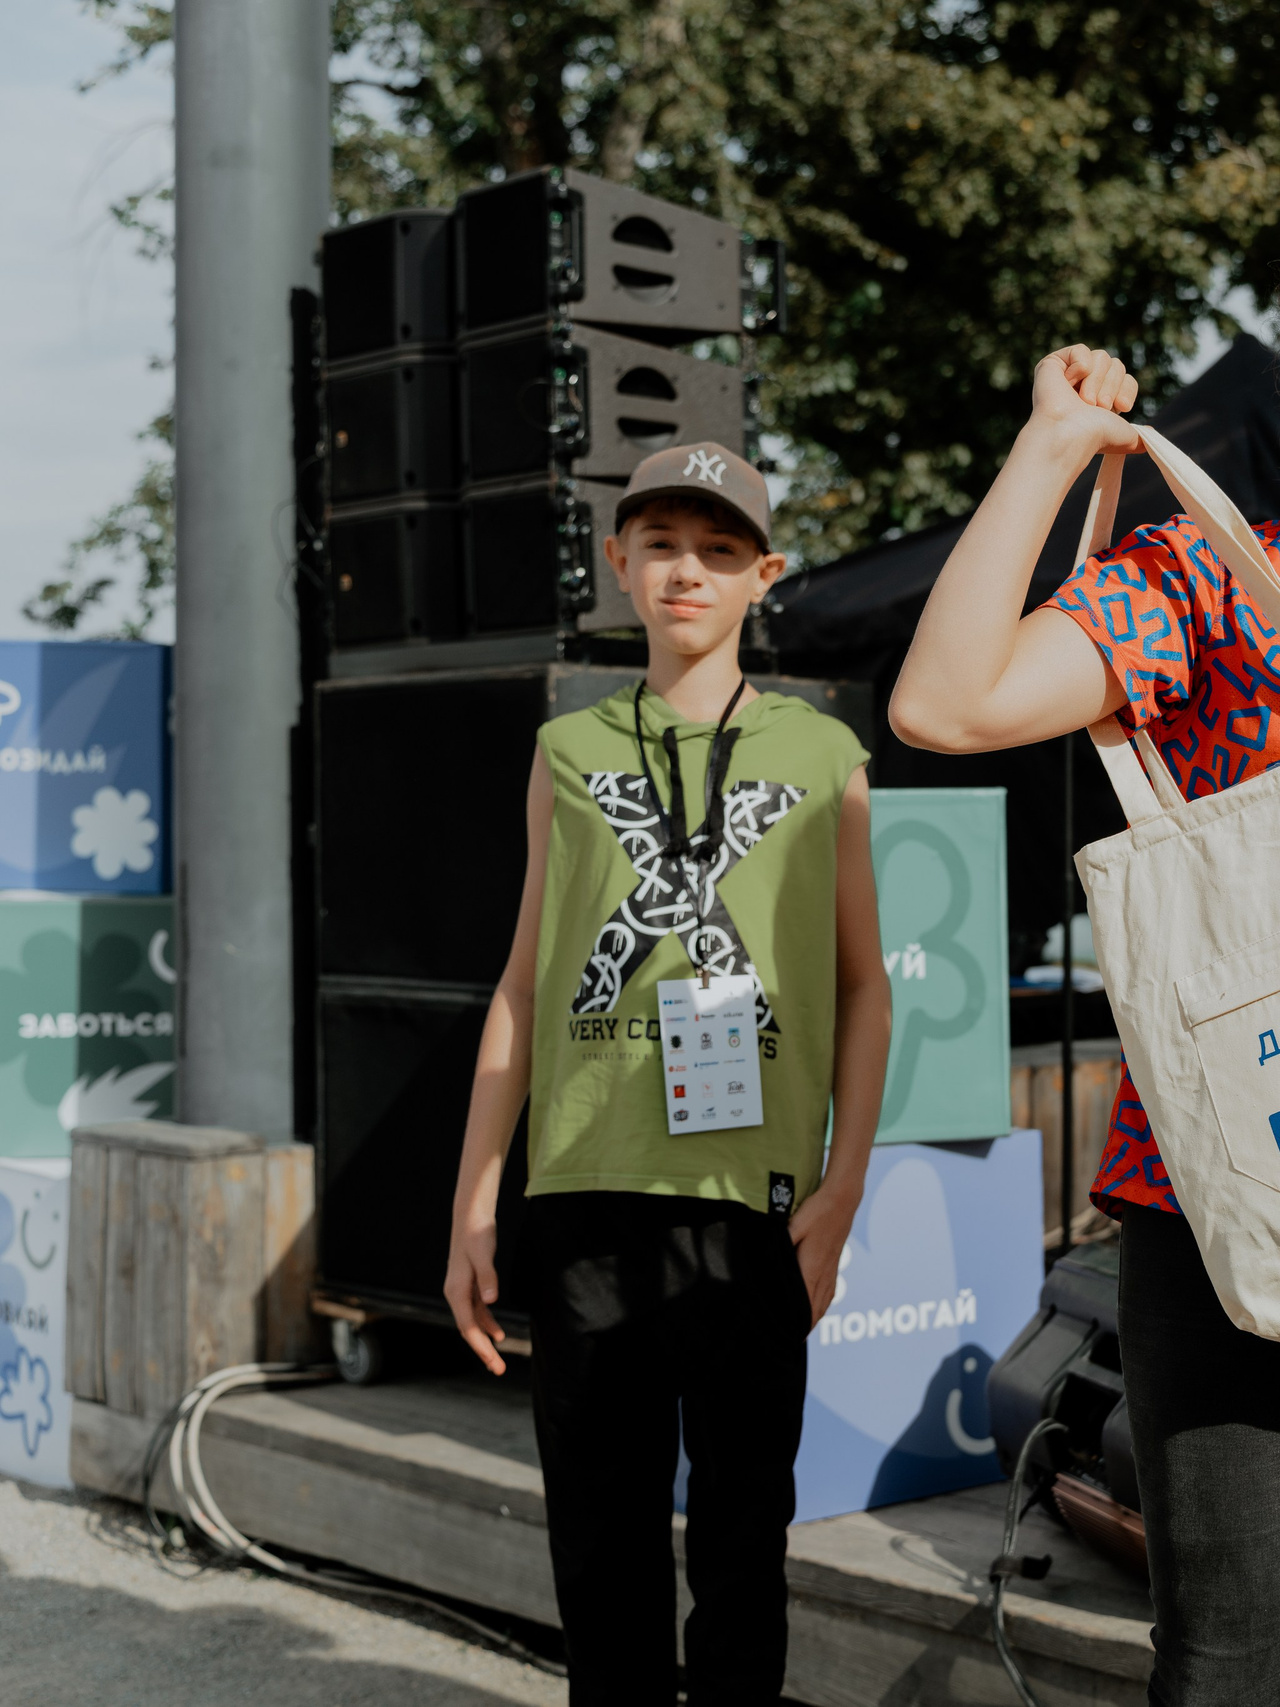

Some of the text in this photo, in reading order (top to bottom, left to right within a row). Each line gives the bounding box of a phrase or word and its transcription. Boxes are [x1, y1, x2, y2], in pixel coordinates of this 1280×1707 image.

[683, 449, 727, 486] NY
[18, 1012, 174, 1038] ЗАБОТЬСЯ
[569, 1018, 618, 1040] VERY
[819, 1288, 977, 1346] ПОМОГАЙ
